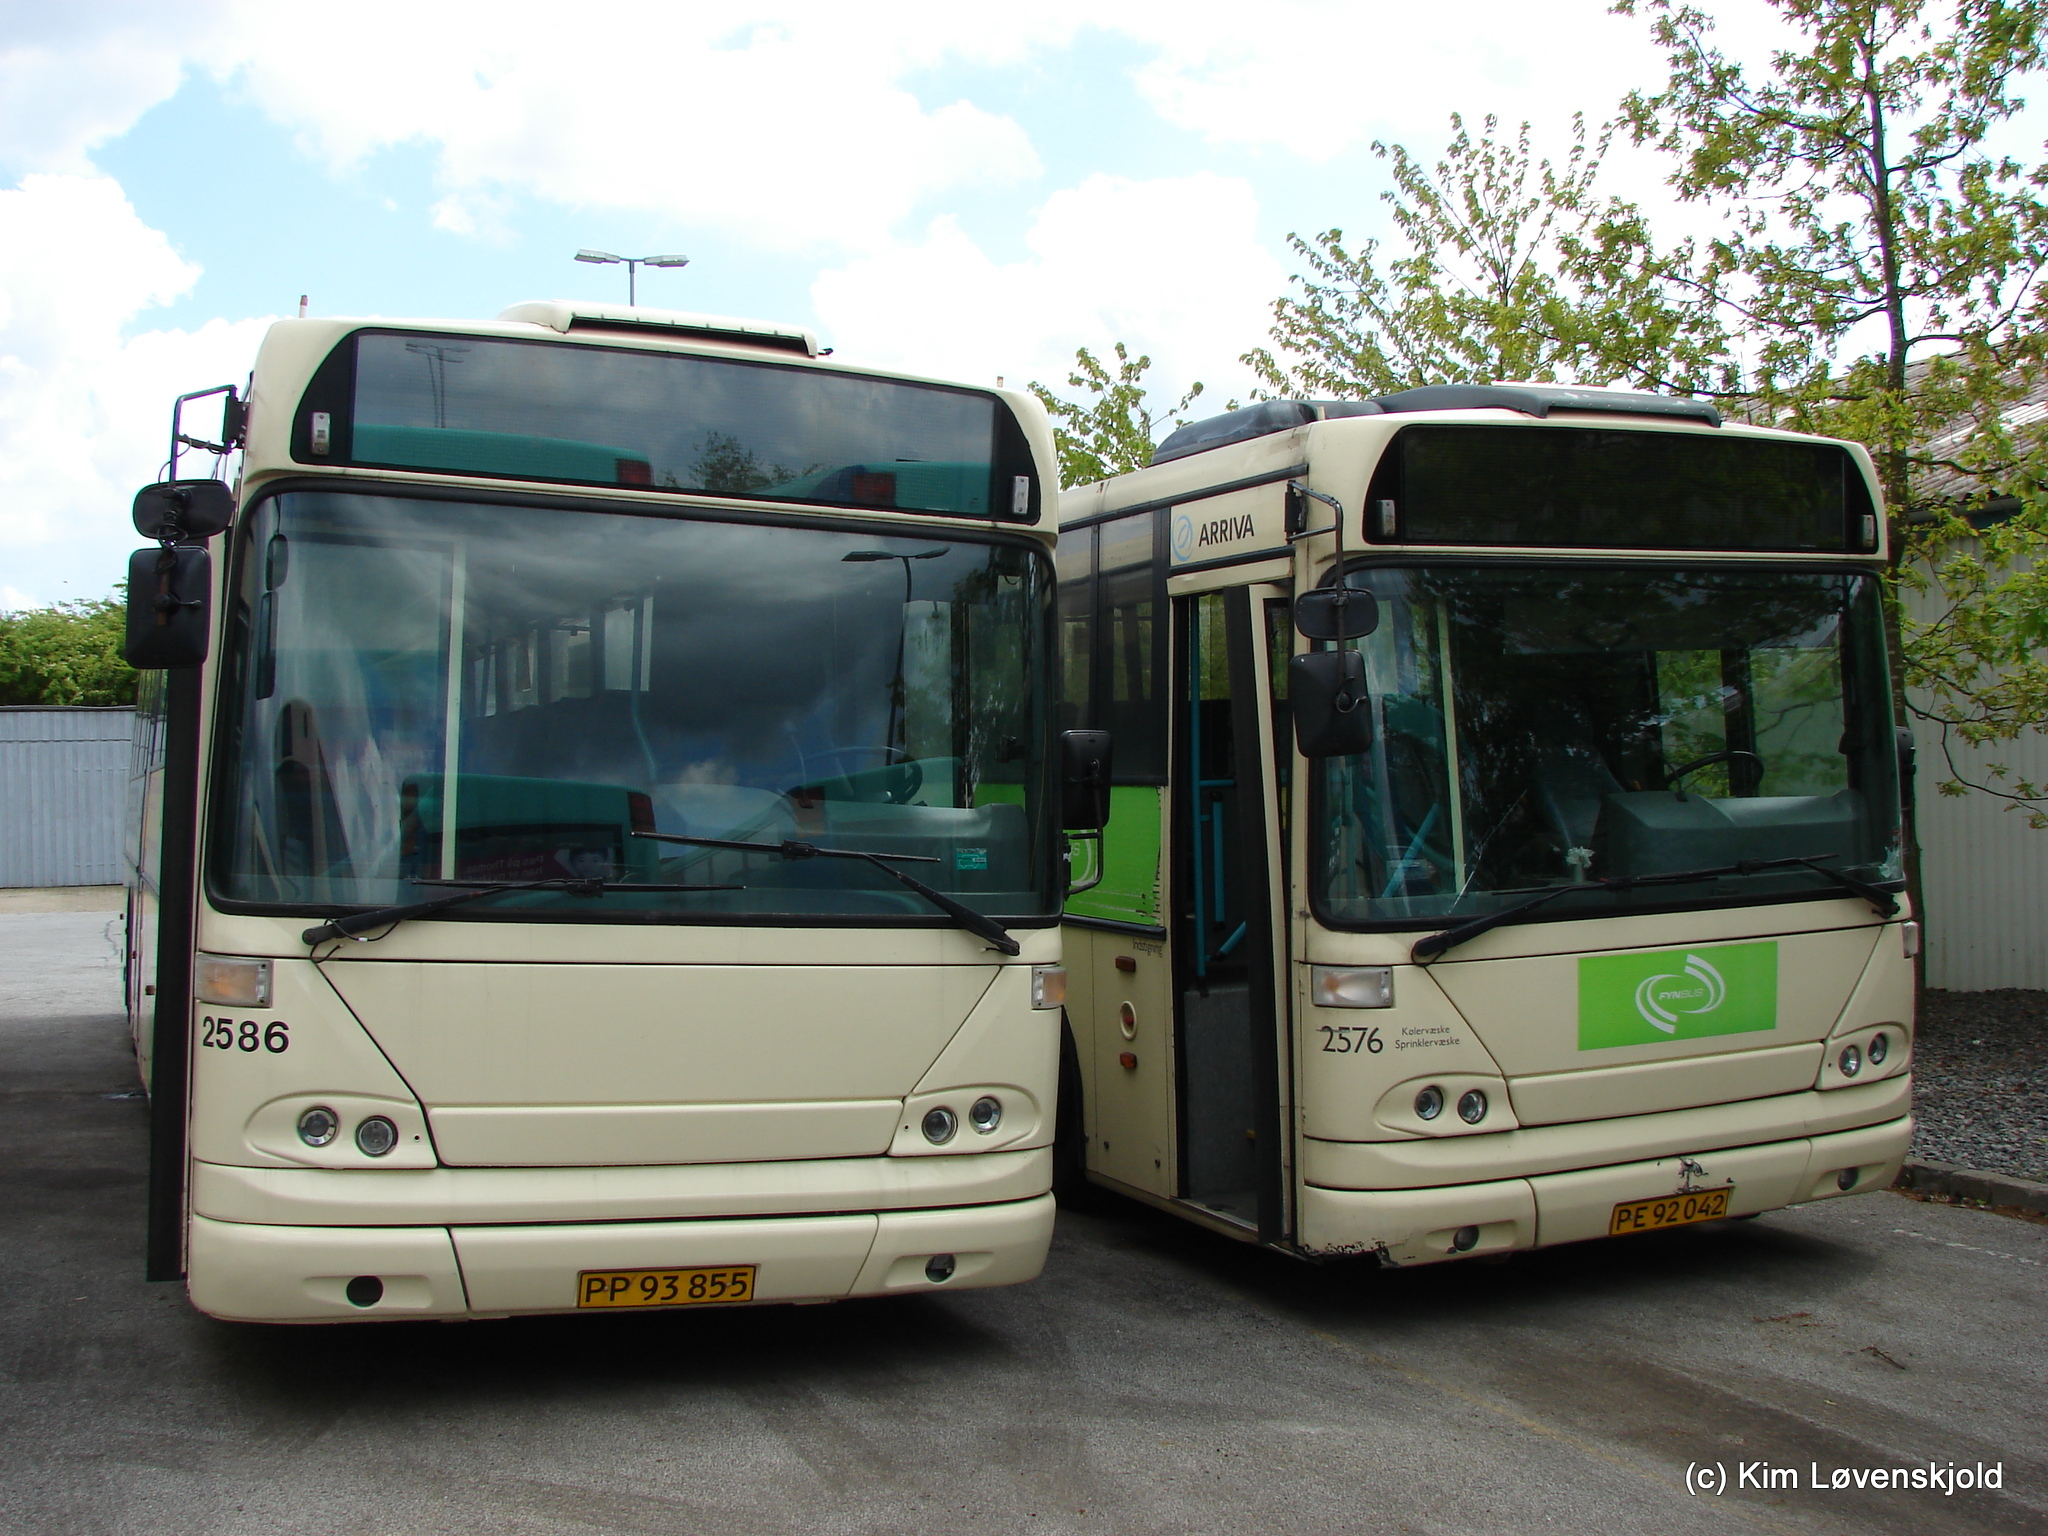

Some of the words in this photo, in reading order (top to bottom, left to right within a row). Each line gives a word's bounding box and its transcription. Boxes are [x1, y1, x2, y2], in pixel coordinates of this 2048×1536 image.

[1198, 513, 1255, 547] ARRIVA
[1132, 937, 1163, 959] Indstigning
[1658, 988, 1704, 1001] FYNBUS
[202, 1015, 290, 1054] 2586
[1320, 1025, 1384, 1054] 2576
[1395, 1036, 1461, 1051] Sprinklervæske
[1616, 1205, 1649, 1231] PE
[1653, 1201, 1680, 1225] 92
[1683, 1194, 1724, 1220] 042
[585, 1276, 631, 1303] PP
[640, 1275, 679, 1301] 93
[688, 1272, 748, 1299] 855
